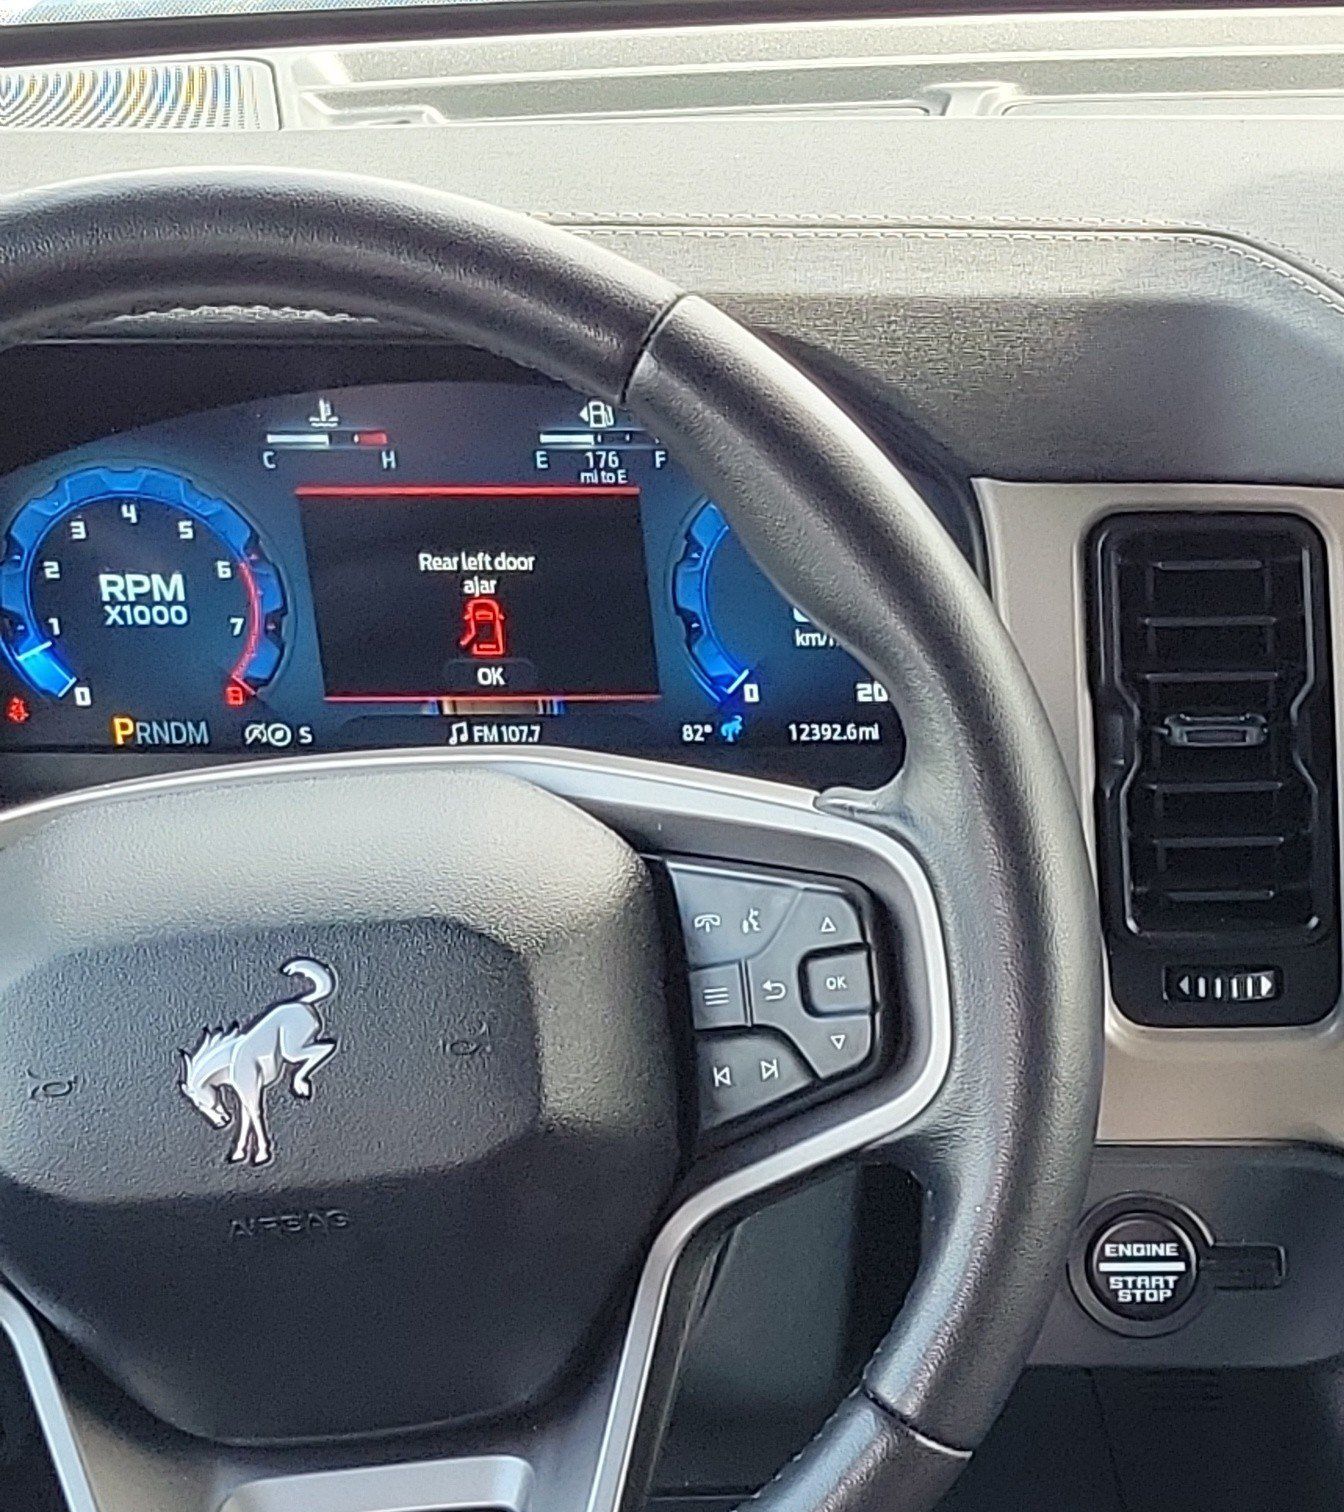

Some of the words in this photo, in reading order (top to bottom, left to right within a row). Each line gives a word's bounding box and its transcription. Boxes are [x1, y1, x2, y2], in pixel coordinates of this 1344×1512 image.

[263, 452, 276, 469] C
[381, 452, 396, 469] H
[536, 451, 549, 469] E
[585, 451, 619, 469] 176
[654, 451, 667, 469] F
[617, 468, 629, 484] E
[122, 504, 138, 523] 4
[71, 523, 87, 541] 3
[178, 522, 194, 540] 5
[44, 561, 60, 579] 2
[217, 561, 232, 579] 6
[418, 552, 459, 571] Rear
[461, 551, 492, 571] left
[494, 551, 535, 571] door
[99, 573, 186, 602] RPM
[463, 576, 497, 597] ajar
[105, 605, 188, 626] X1000
[48, 618, 60, 635] 1
[230, 617, 243, 635] 7
[477, 667, 505, 686] OK
[75, 687, 91, 706] 0
[743, 684, 760, 703] 0
[856, 681, 888, 702] 20
[300, 726, 313, 743] S
[473, 724, 499, 742] FM
[501, 724, 540, 742] 107.7
[826, 976, 848, 990] OK
[1104, 1243, 1179, 1258] ENGINE
[1109, 1275, 1179, 1290] START
[1117, 1290, 1173, 1303] STOP
